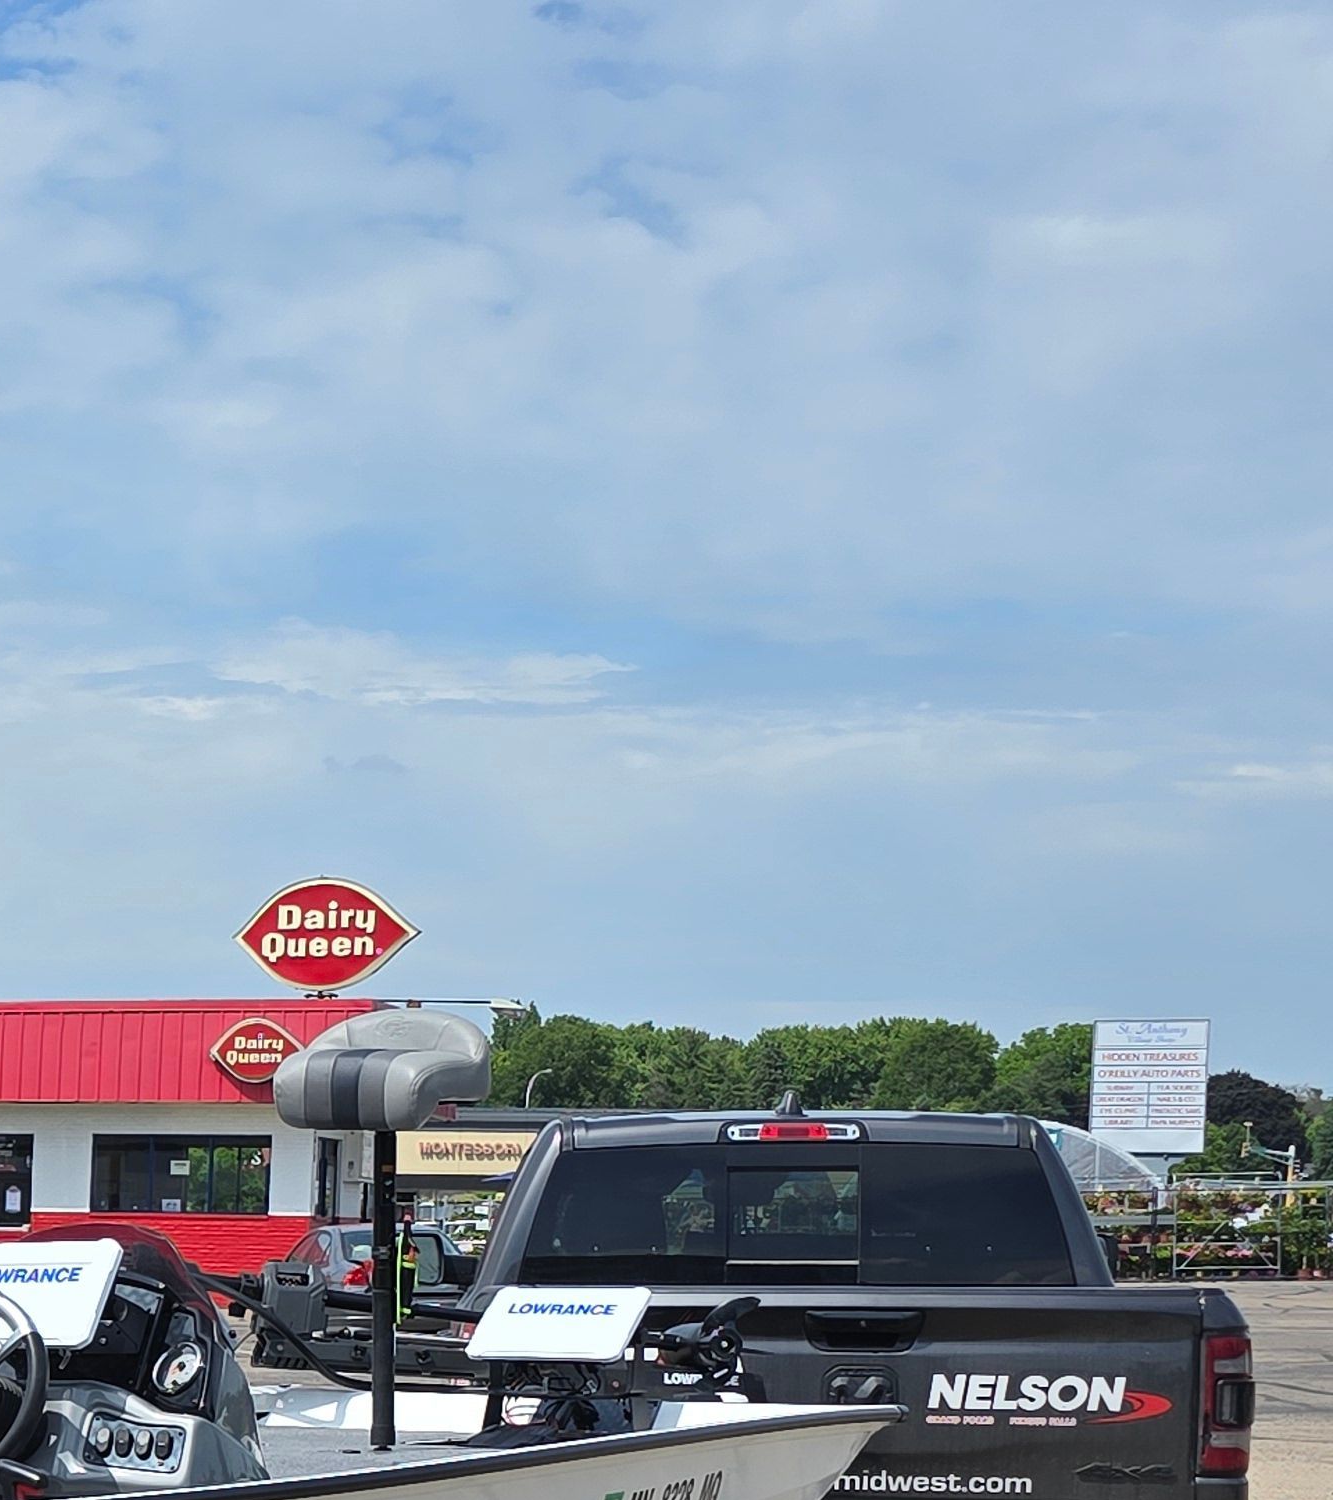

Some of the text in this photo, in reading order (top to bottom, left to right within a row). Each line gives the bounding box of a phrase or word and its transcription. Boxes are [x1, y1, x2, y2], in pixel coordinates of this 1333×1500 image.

[277, 900, 377, 933] Dairy
[261, 932, 375, 962] Queen
[234, 1032, 284, 1050] Dairy
[226, 1050, 283, 1066] Queen
[1102, 1052, 1199, 1061] HIDDEN TREASURES
[1097, 1069, 1201, 1078] O'REILLY AUTO PARTS
[418, 1142, 522, 1158] MONTESSORI
[507, 1302, 619, 1316] LOWRANCE
[926, 1373, 1127, 1412] NELSON
